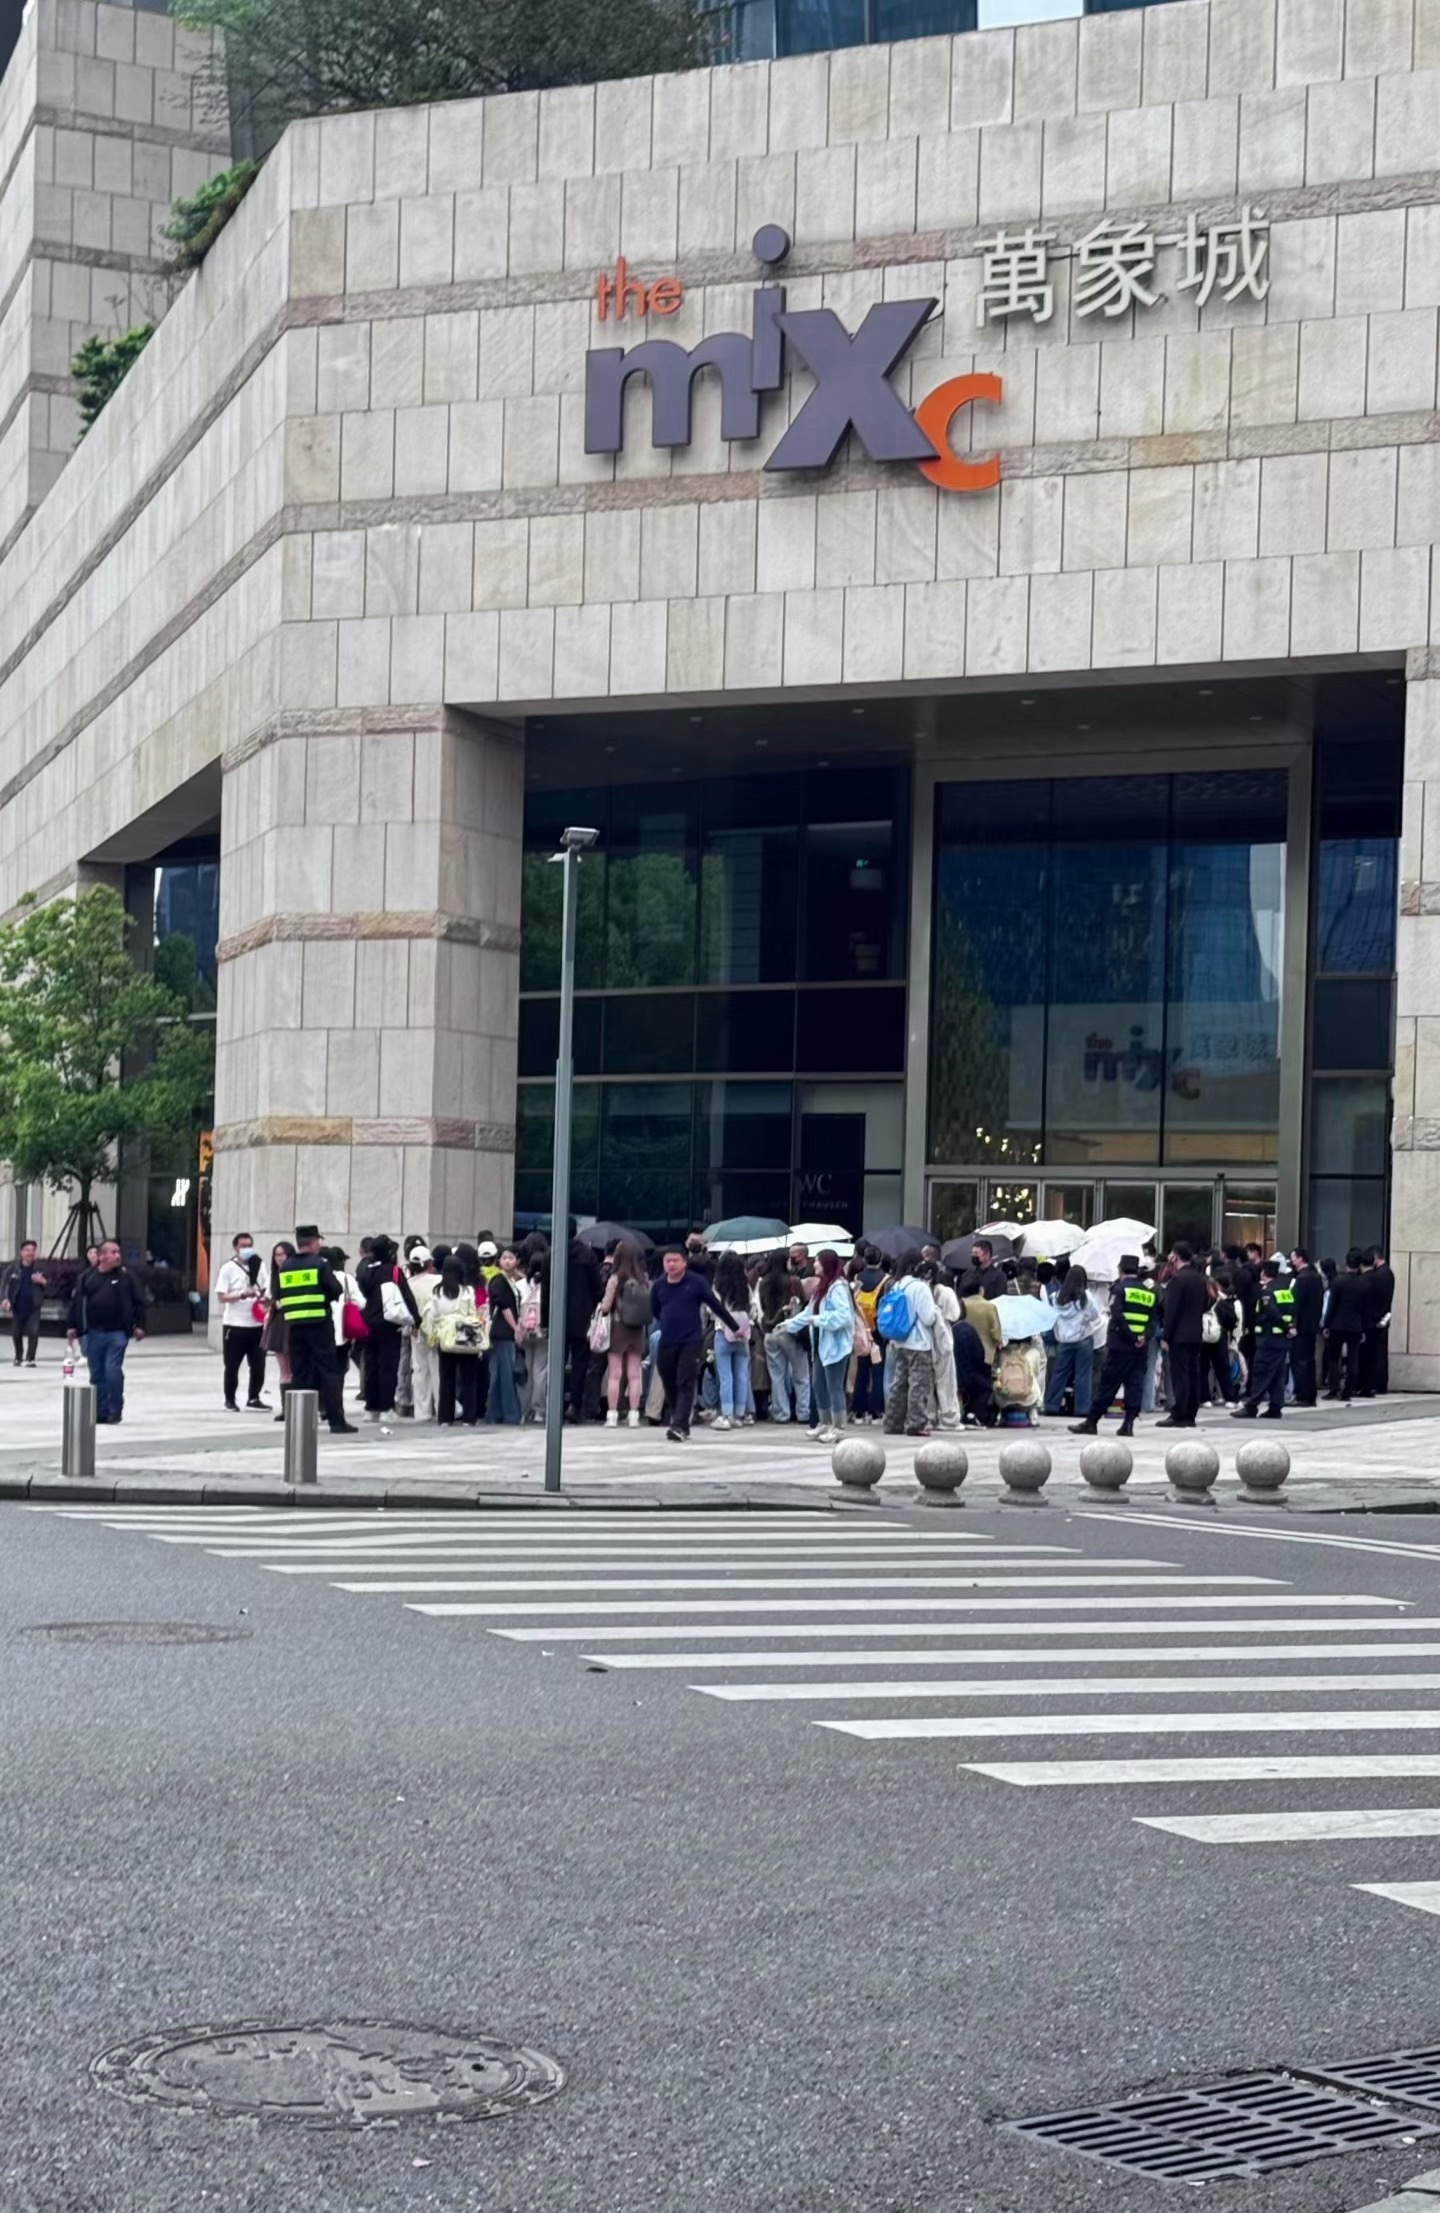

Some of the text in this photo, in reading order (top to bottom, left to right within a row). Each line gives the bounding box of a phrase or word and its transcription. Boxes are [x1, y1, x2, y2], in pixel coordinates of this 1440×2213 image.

[596, 256, 683, 321] the
[973, 205, 1270, 328] 萬象城
